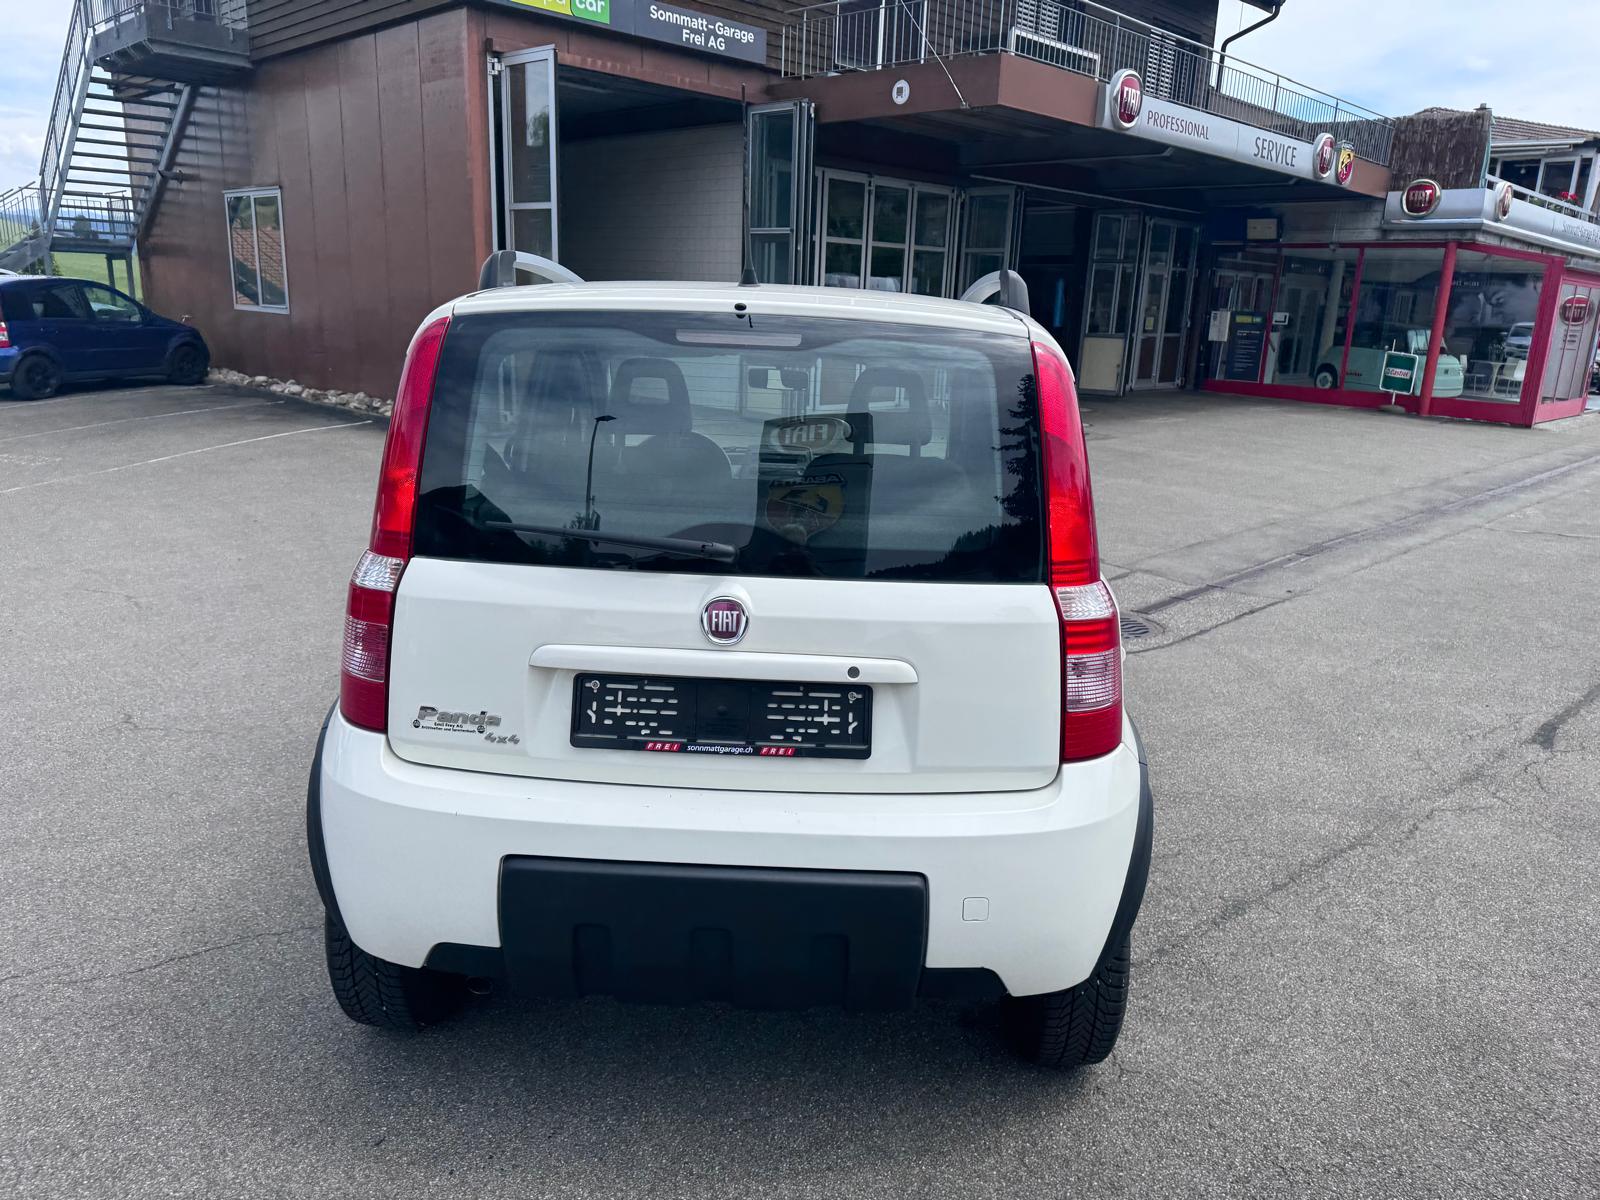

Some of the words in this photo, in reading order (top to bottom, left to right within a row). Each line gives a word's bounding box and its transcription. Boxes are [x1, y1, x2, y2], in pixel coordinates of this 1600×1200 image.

[650, 5, 754, 43] Sonnmatt-Garage
[682, 29, 705, 46] Frei
[707, 35, 726, 51] AG
[1122, 86, 1141, 116] FIAT
[1147, 110, 1210, 140] PROFESSIONAL
[1253, 136, 1297, 168] SERVICE
[1407, 189, 1433, 208] FIAT
[1390, 368, 1409, 378] Castrol
[711, 610, 740, 633] FIAT
[418, 706, 501, 726] Panda
[484, 732, 520, 745] 4x4
[646, 743, 678, 751] FREI
[687, 744, 754, 754] sonnmattgarage.ch
[761, 747, 793, 755] FREI
